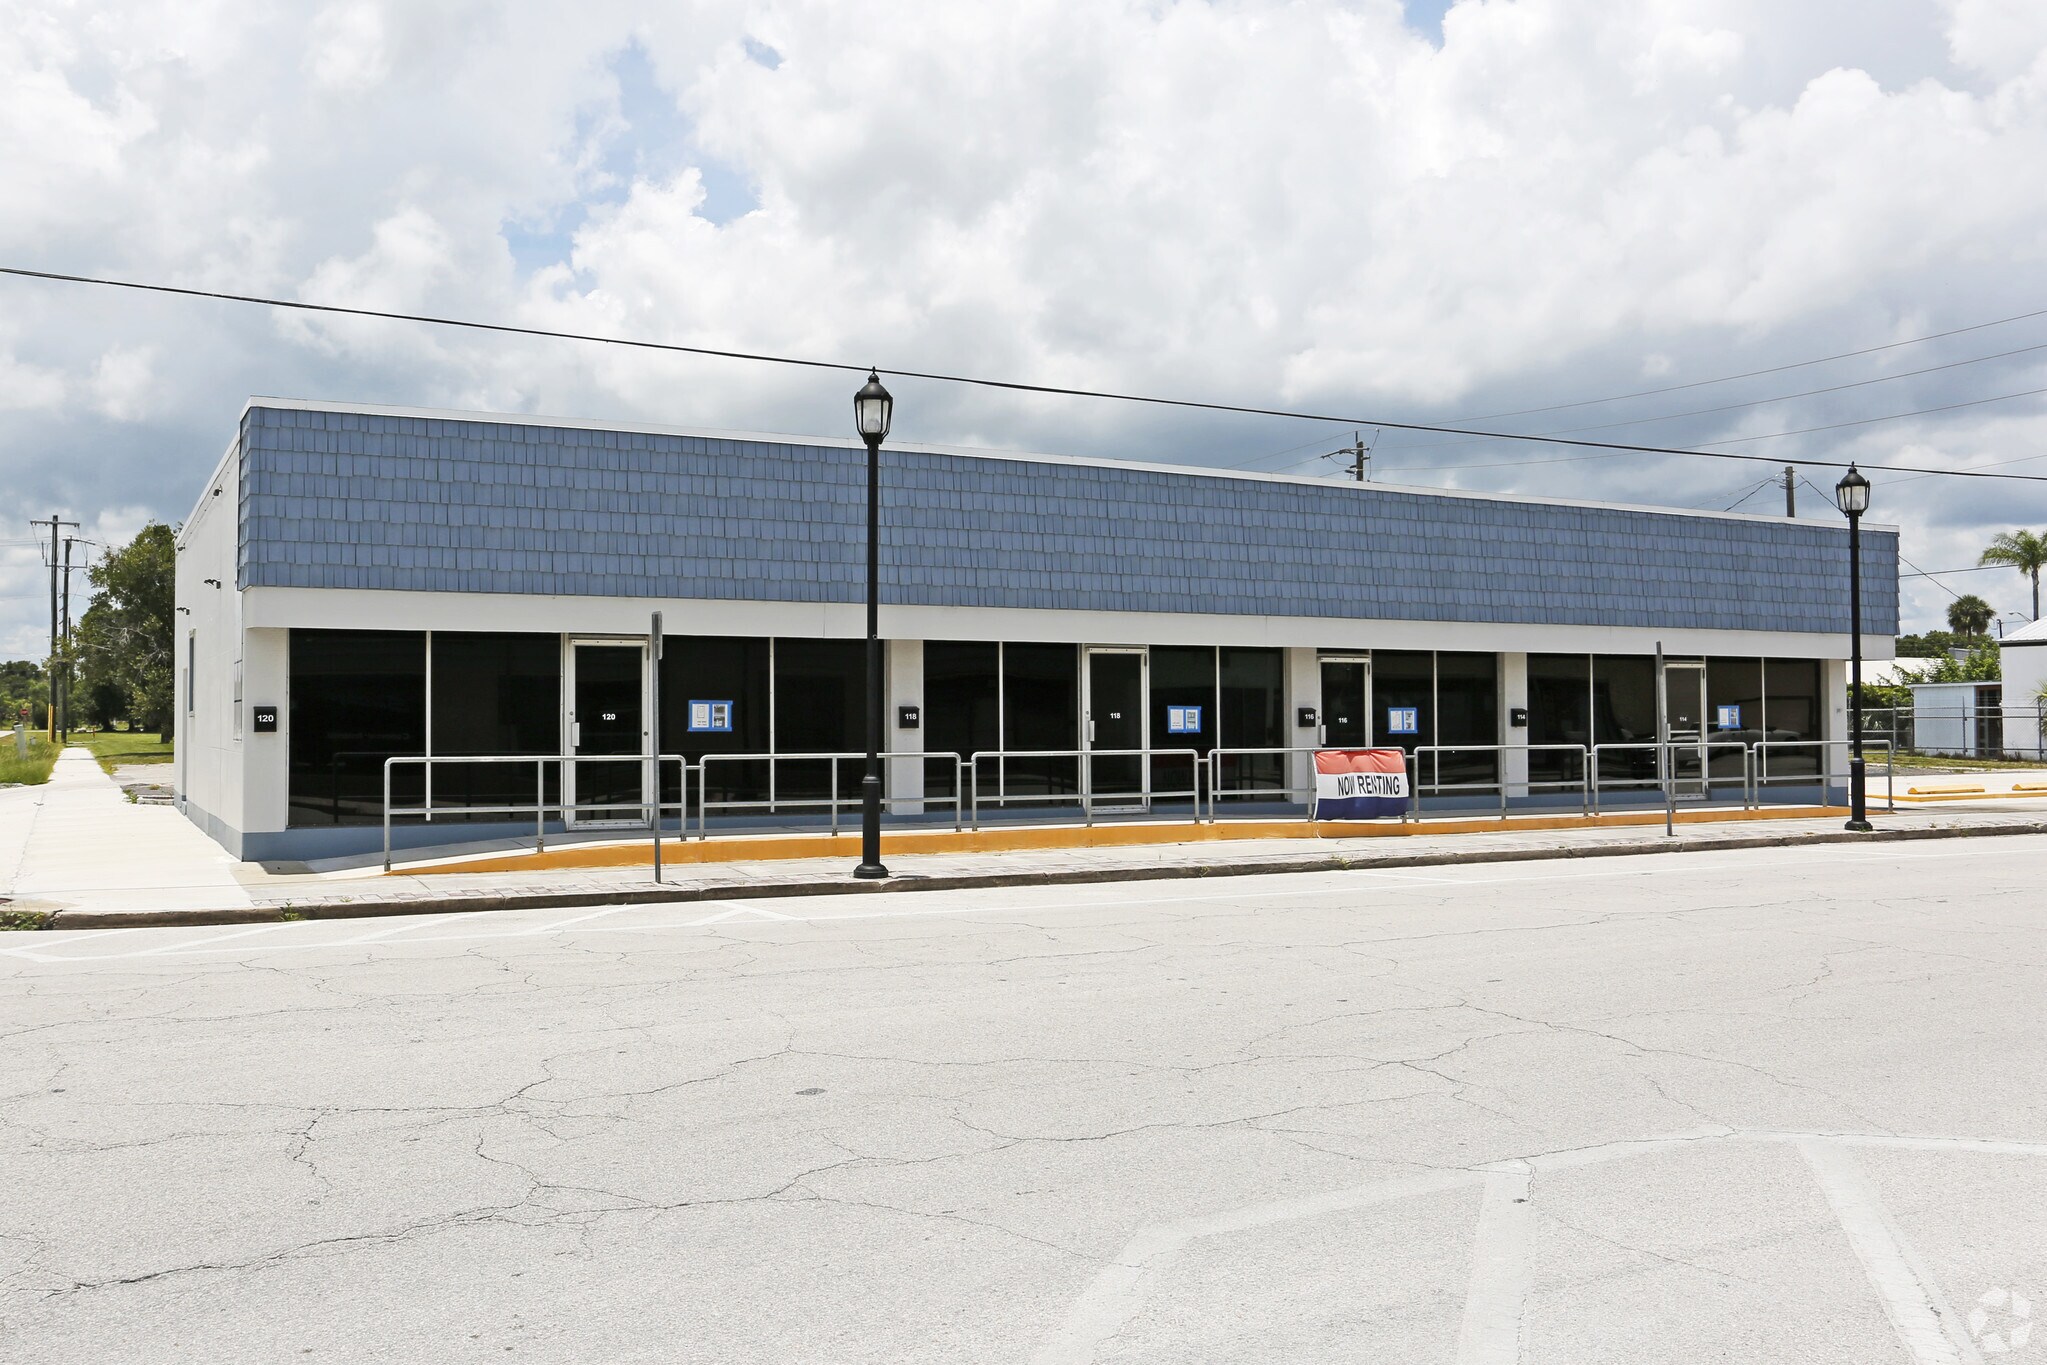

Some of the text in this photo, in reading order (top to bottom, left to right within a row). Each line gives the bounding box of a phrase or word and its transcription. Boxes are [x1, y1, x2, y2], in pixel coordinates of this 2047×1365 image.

[257, 714, 275, 723] 120
[1337, 775, 1400, 796] NOW RENTING
